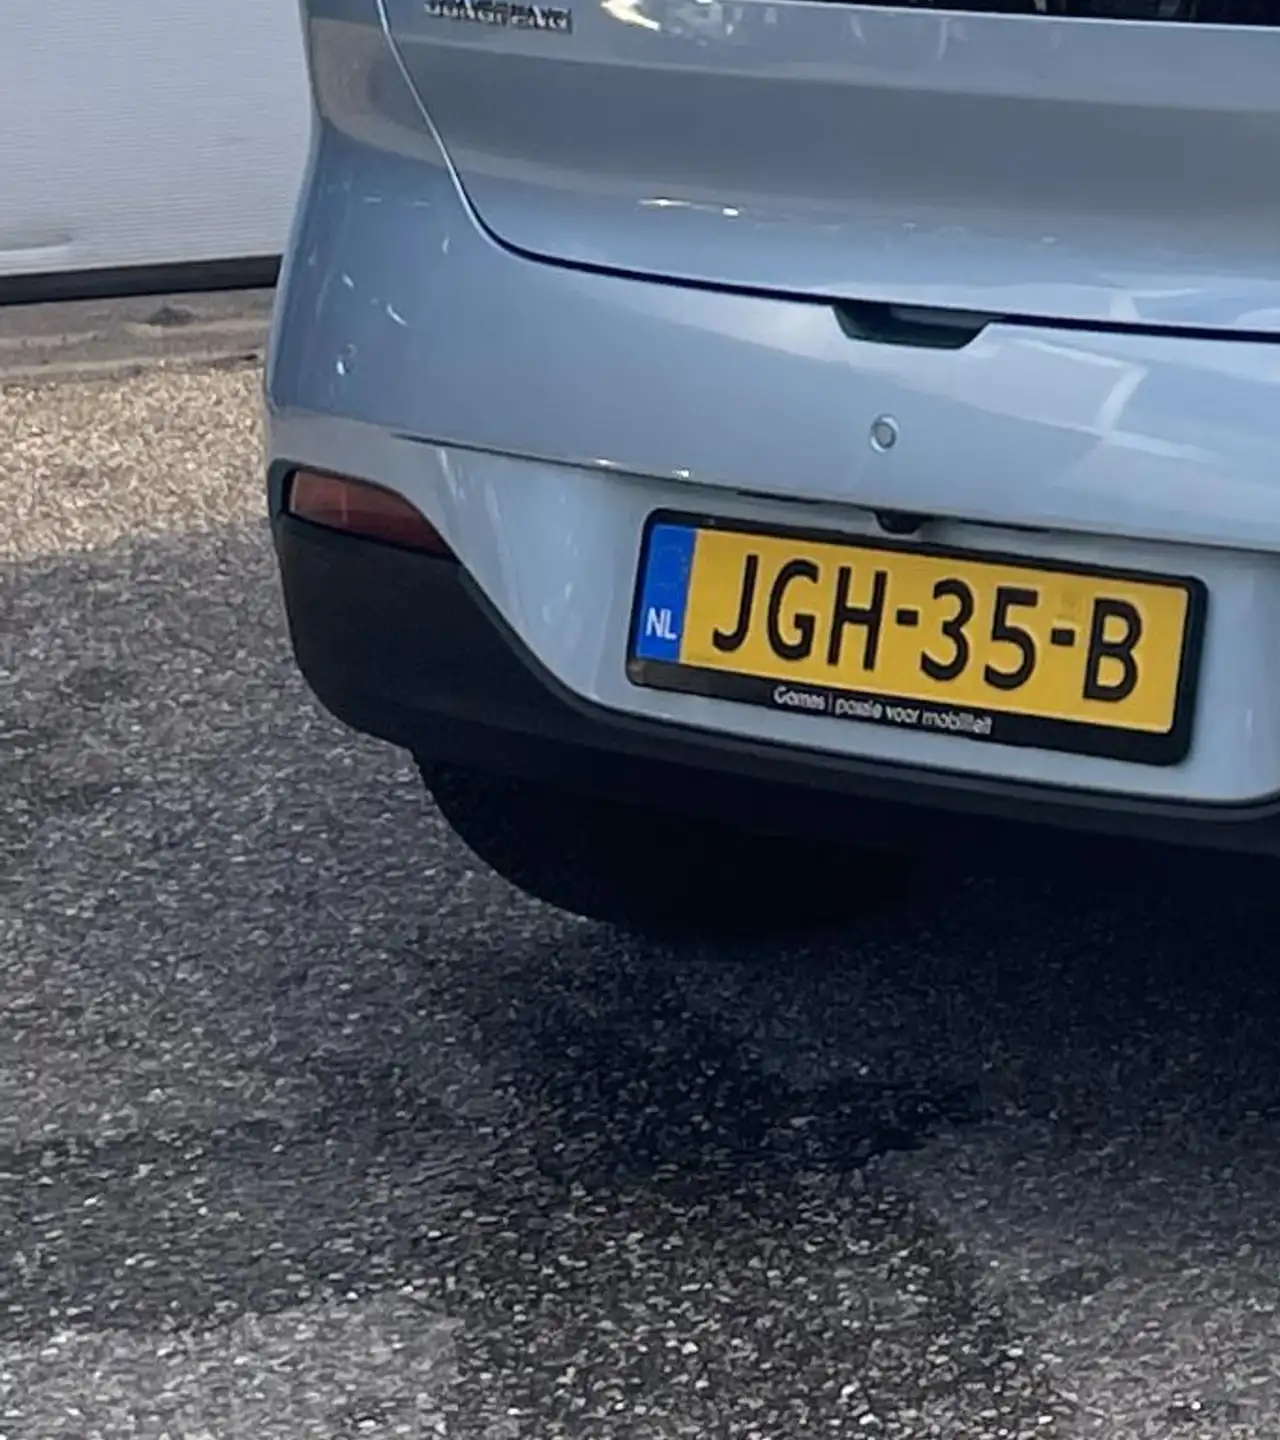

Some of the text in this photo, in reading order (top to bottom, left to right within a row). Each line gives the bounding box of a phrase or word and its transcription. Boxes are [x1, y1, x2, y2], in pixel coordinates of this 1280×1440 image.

[645, 607, 677, 640] NL
[711, 553, 1143, 703] JGH-35-B
[885, 705, 920, 724] voor
